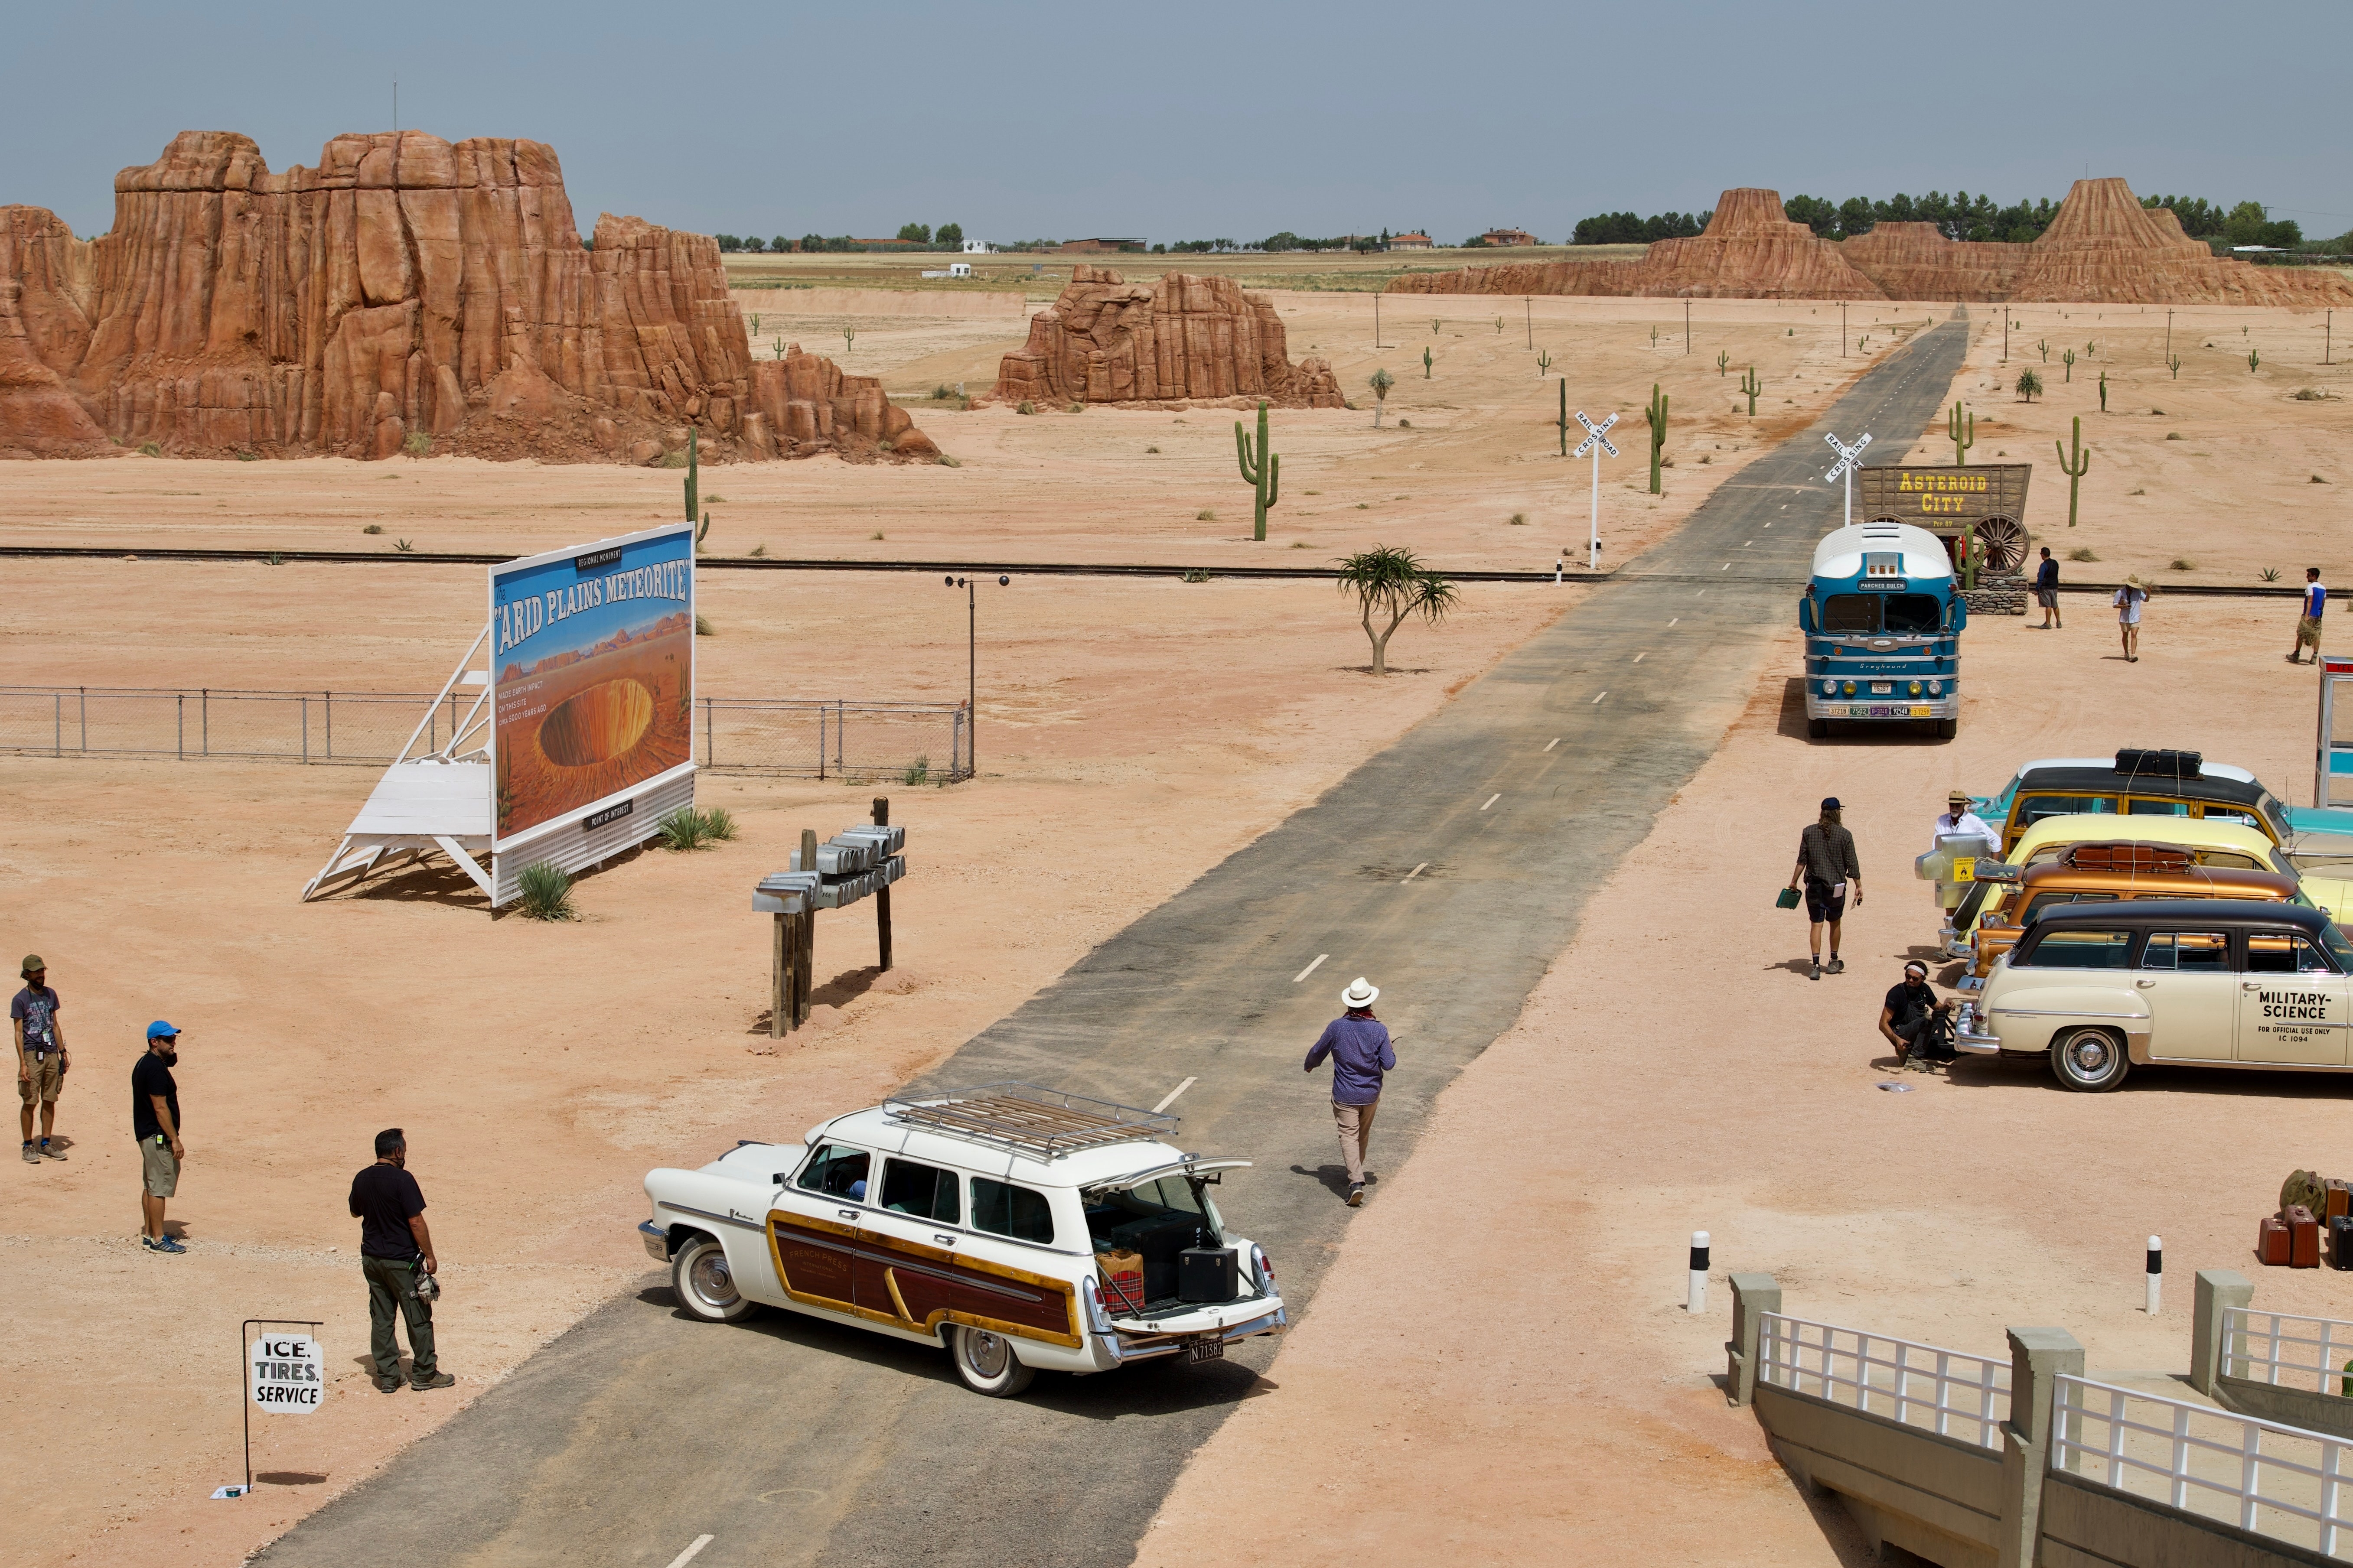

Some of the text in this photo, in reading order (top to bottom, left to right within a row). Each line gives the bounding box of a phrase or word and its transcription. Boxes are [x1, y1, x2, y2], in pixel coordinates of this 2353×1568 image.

[1578, 414, 1616, 455] RAIL ROAD
[1578, 418, 1613, 452] CROSSING
[1828, 436, 1843, 453] RAIL
[1831, 439, 1866, 477] CROSSING
[1900, 473, 1987, 491] ASTEROID
[1922, 494, 1964, 512] CITY
[578, 549, 620, 568] REGIONAL MONUMENT
[495, 583, 506, 601] The
[546, 577, 602, 626] PLAINS
[499, 680, 543, 700] MADE EARTH IMPACT
[499, 698, 527, 713] ON THIS SITE
[508, 712, 521, 722] 5000
[522, 707, 536, 718] YEARS
[537, 704, 546, 713] AGO
[592, 804, 629, 826] POINT OF INTEREST
[2260, 992, 2331, 1005] MILITARY-
[2263, 1005, 2325, 1019] SCIENCE
[789, 1250, 847, 1272] FRENCH PRESS
[802, 1261, 833, 1272] INTERNATIONAL
[1192, 1342, 1222, 1360] N 71382
[255, 1362, 319, 1382] TIRES,
[257, 1386, 318, 1404] SERVICE
